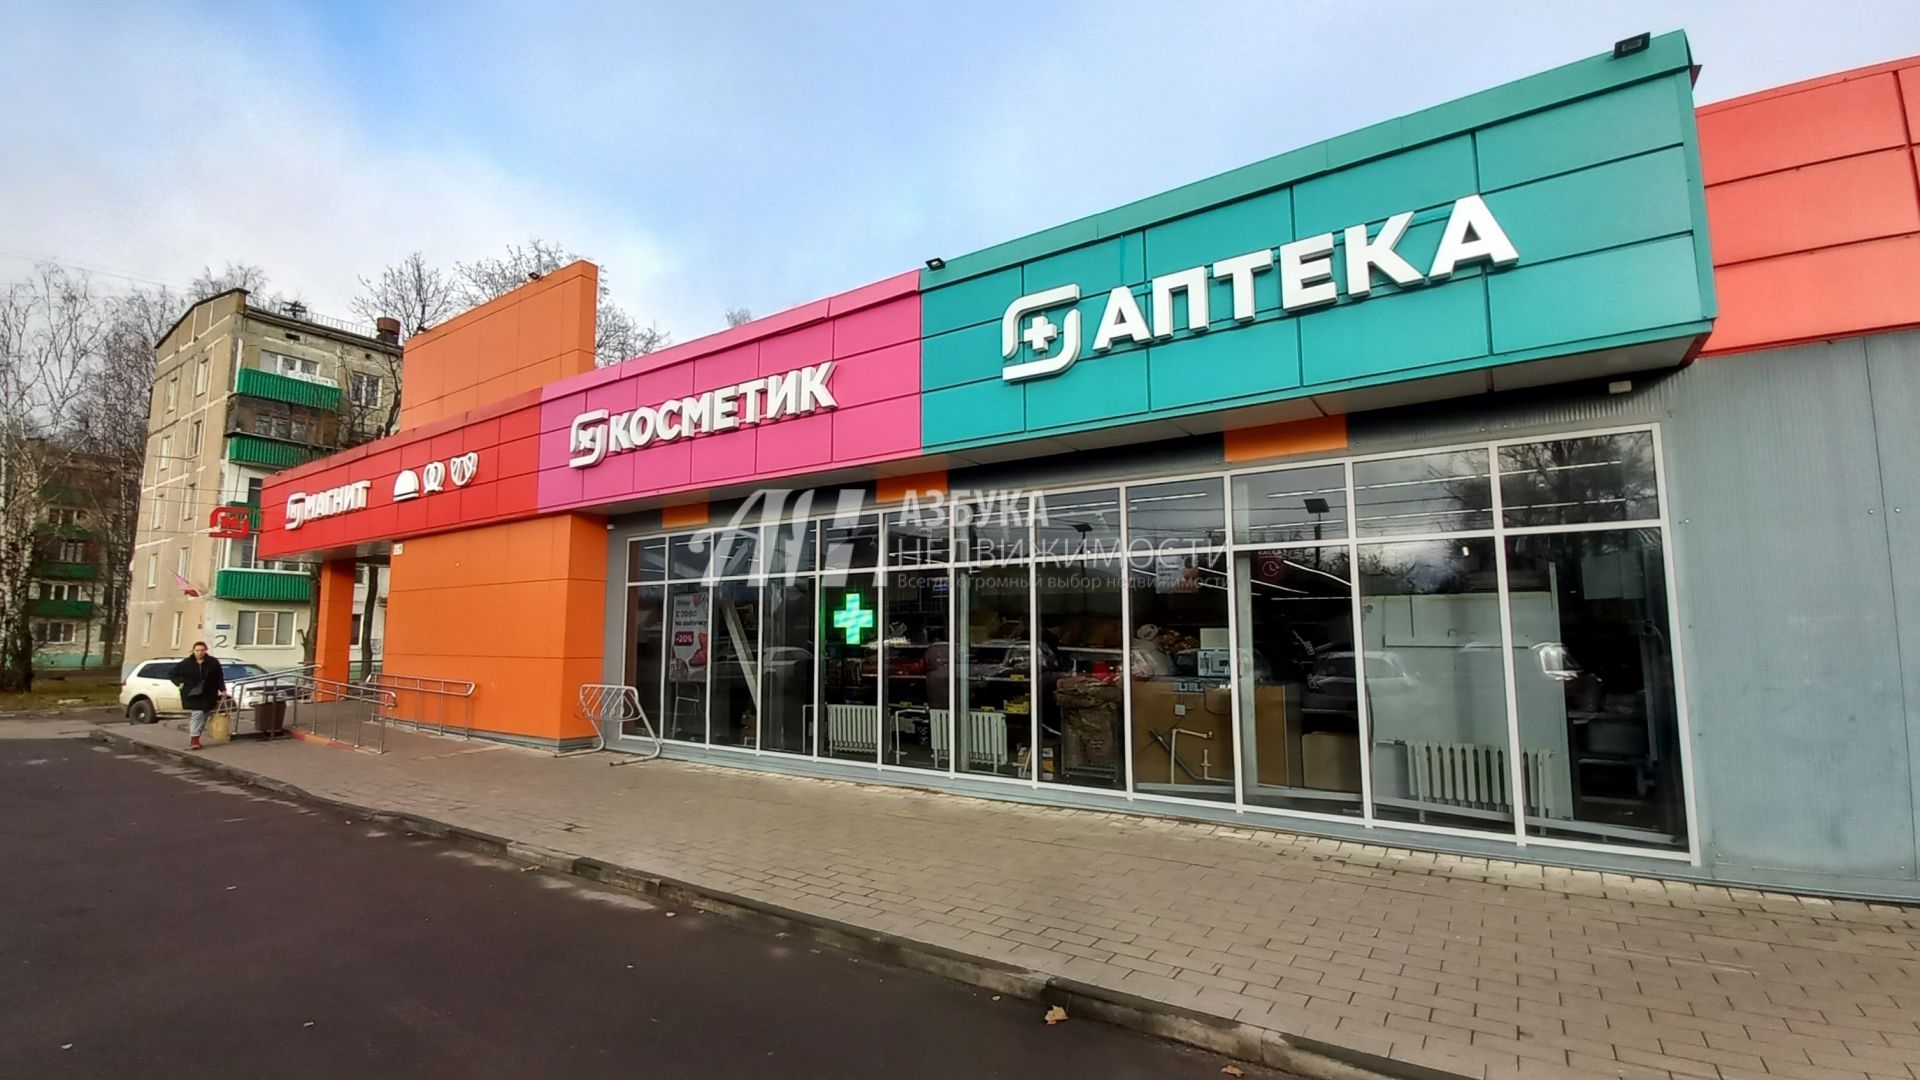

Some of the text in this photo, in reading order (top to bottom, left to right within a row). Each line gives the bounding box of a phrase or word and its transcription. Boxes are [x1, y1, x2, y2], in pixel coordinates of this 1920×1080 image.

[1092, 193, 1519, 353] АПТЕКА
[609, 361, 838, 454] КОСМЕТИК
[304, 479, 372, 521] МАГНИТ
[215, 635, 228, 648] 2
[676, 633, 693, 643] -20%
